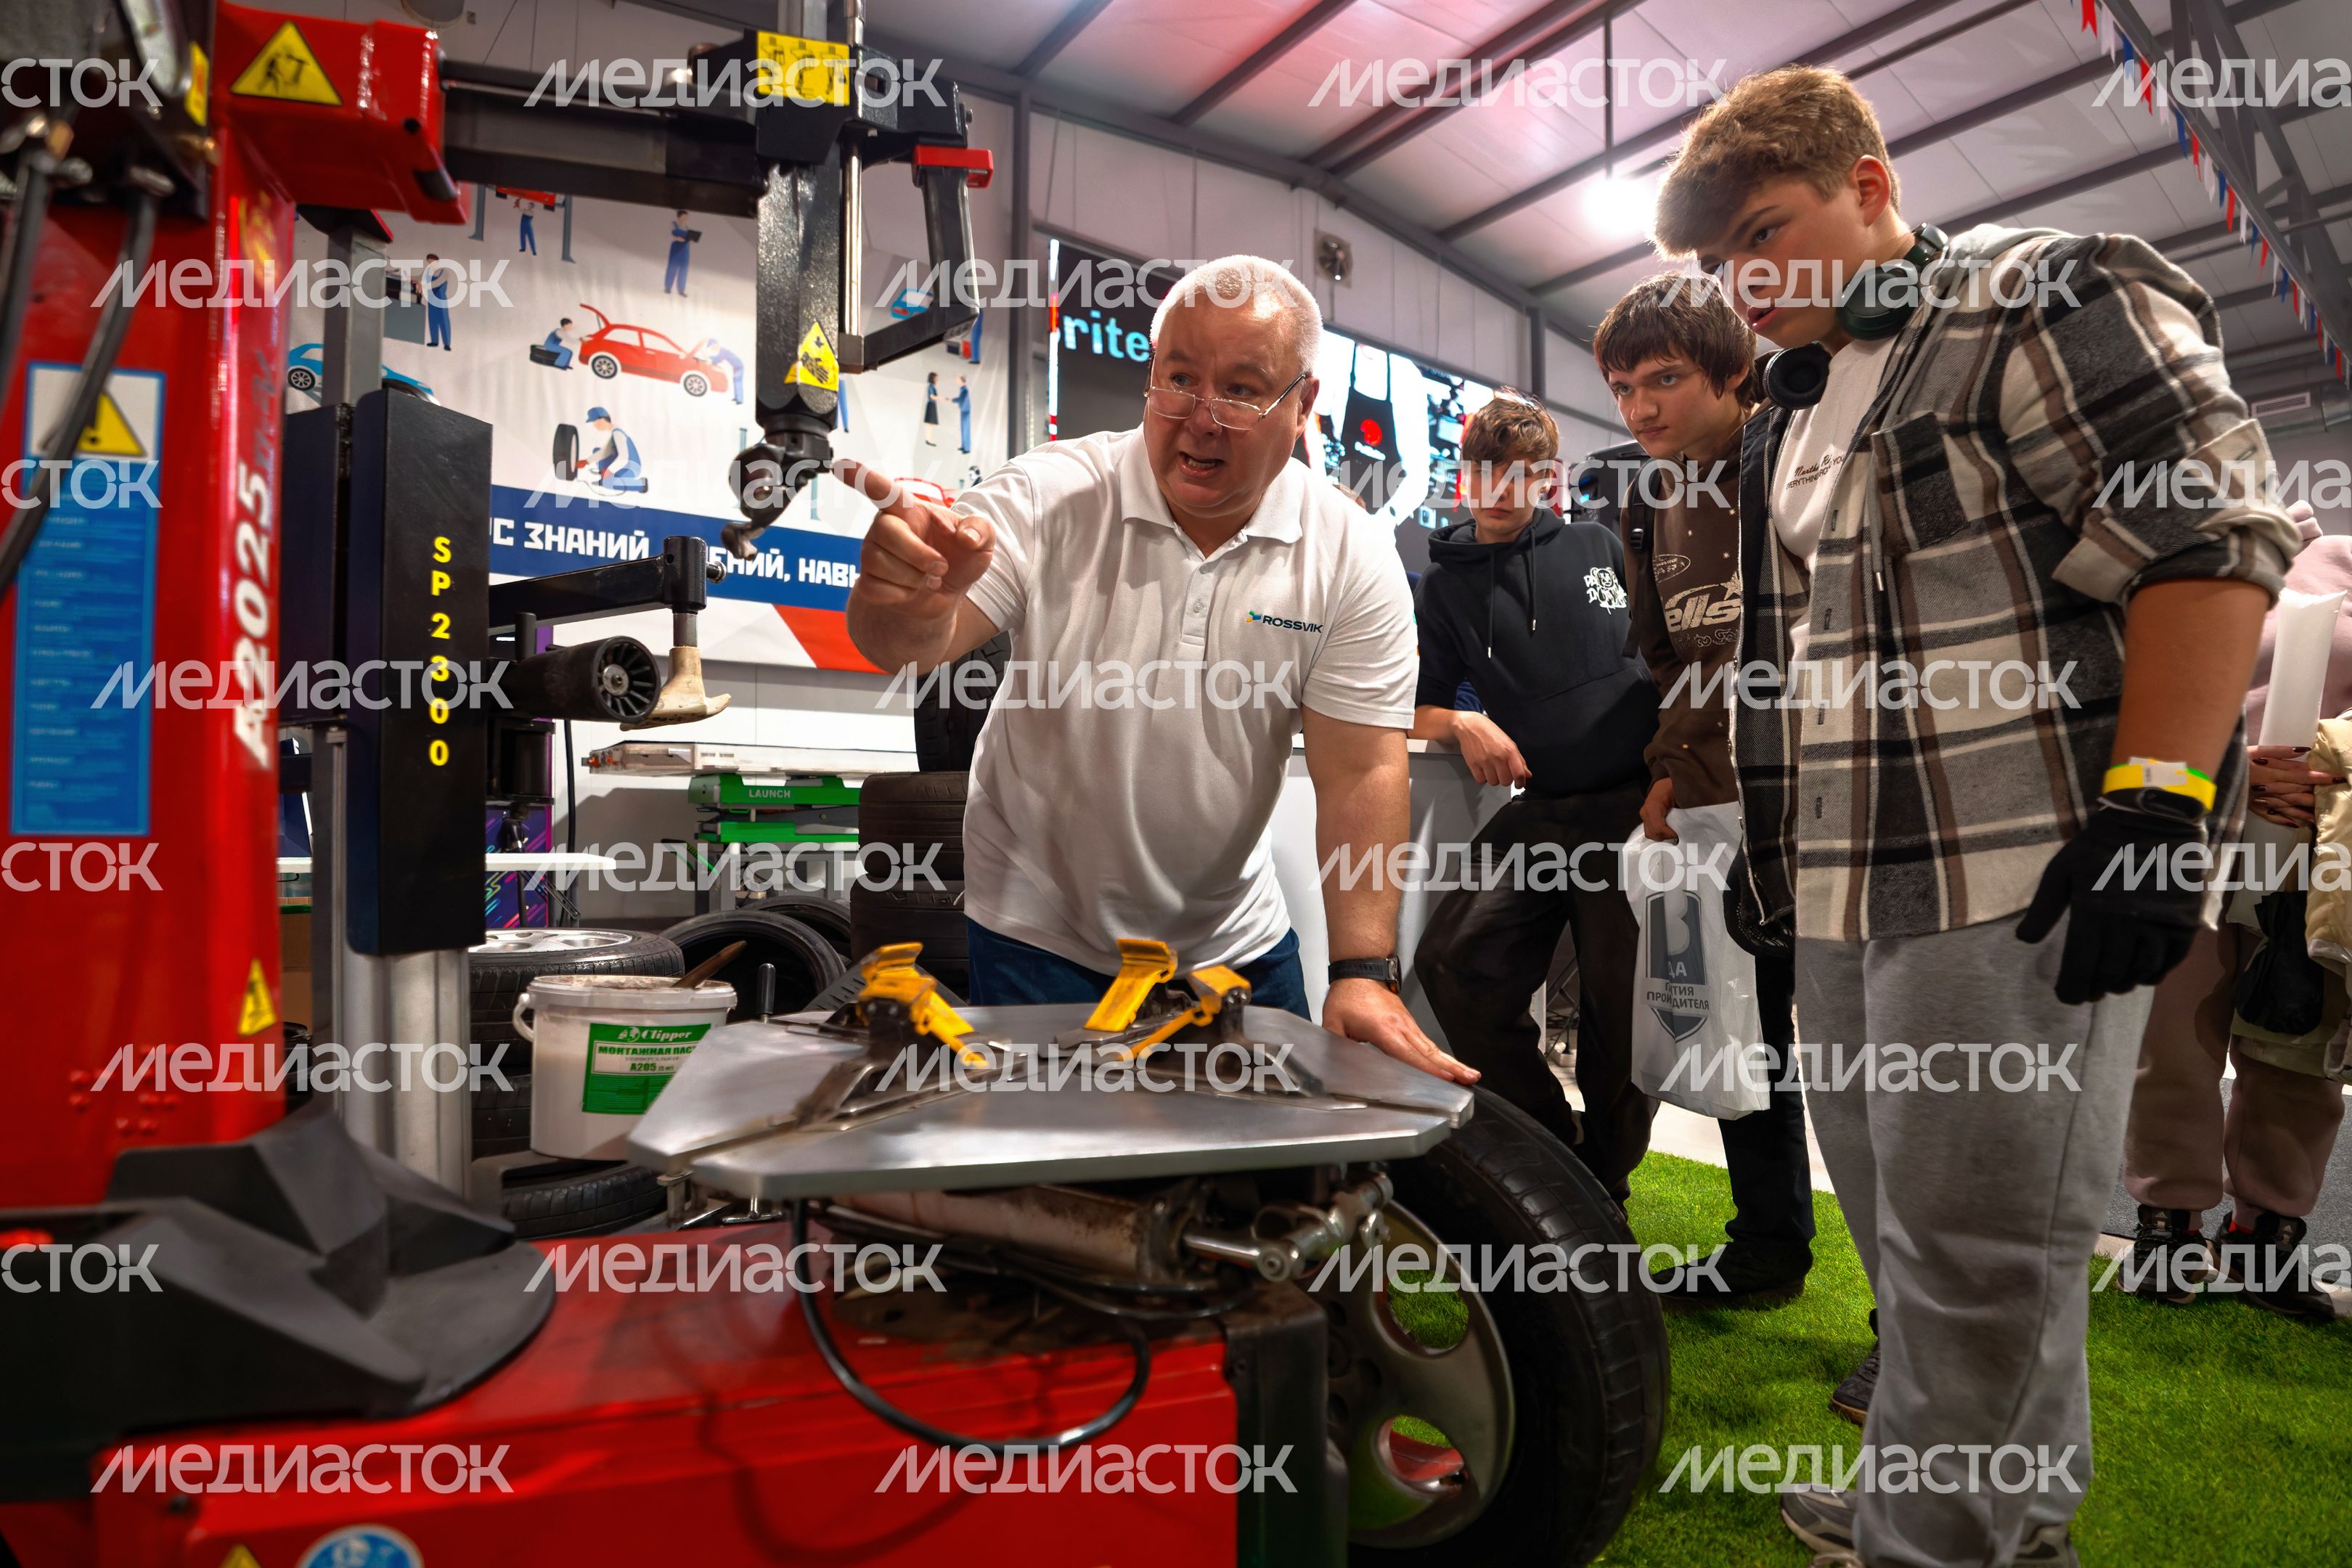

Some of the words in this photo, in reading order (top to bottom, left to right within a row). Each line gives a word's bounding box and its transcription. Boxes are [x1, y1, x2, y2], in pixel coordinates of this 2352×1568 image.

[1057, 309, 1151, 362] rite
[489, 517, 515, 546] С
[523, 521, 650, 560] ЗНАНИЙ
[1262, 615, 1323, 634] ROSSVIK
[748, 789, 791, 799] LAUNCH
[641, 1029, 693, 1042] Clipper
[598, 1046, 671, 1055] МОНТАЖНАЯ
